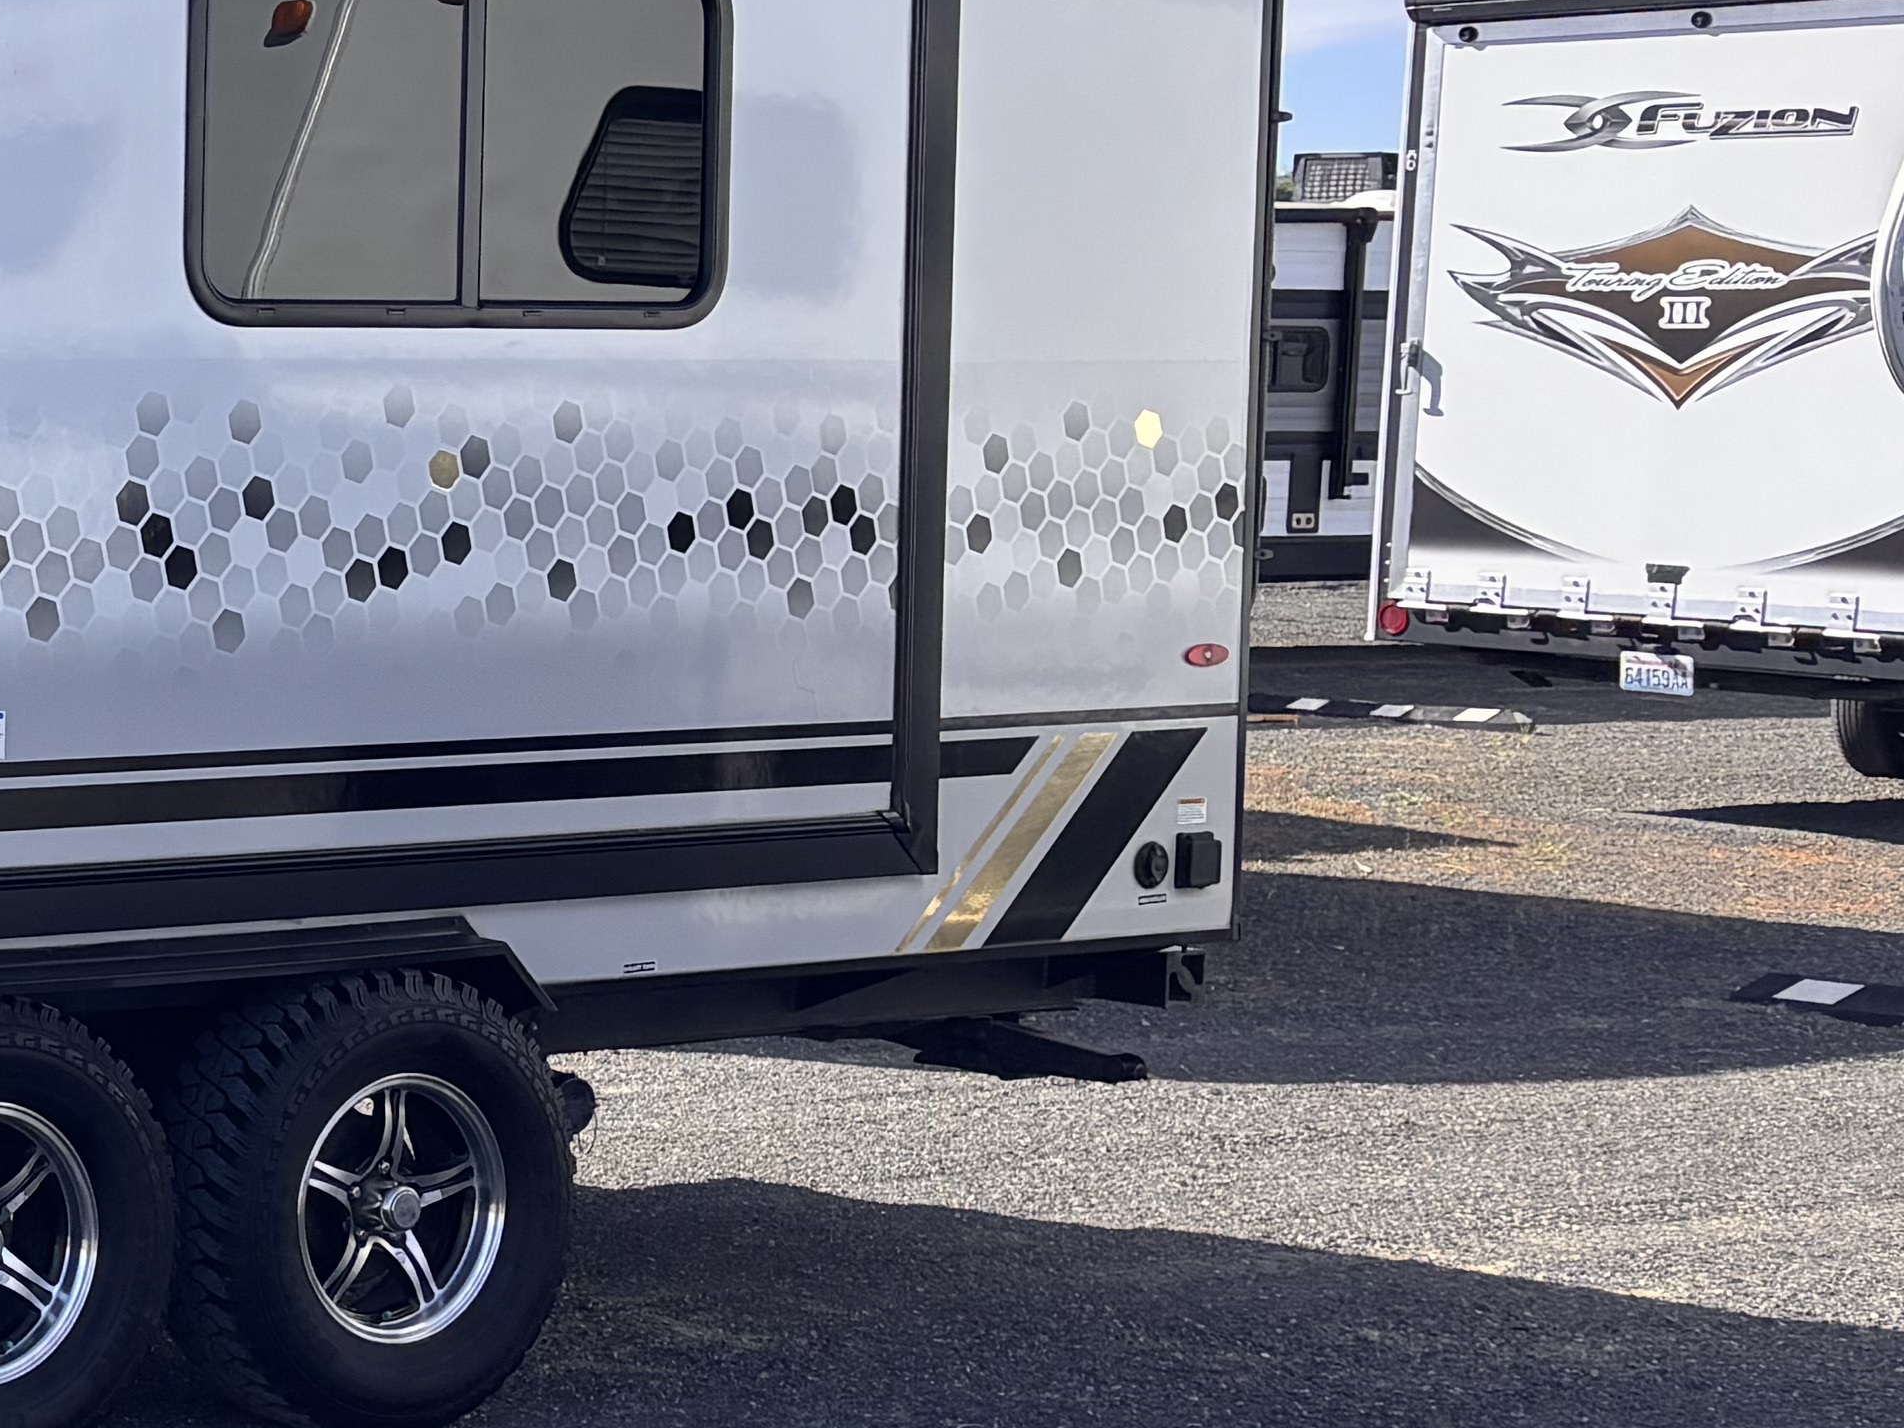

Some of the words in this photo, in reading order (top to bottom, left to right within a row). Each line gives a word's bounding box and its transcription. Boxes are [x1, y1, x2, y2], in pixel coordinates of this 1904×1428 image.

[1636, 102, 1861, 140] FUZION
[1562, 262, 1670, 303] Touring
[1669, 259, 1790, 291] Edition
